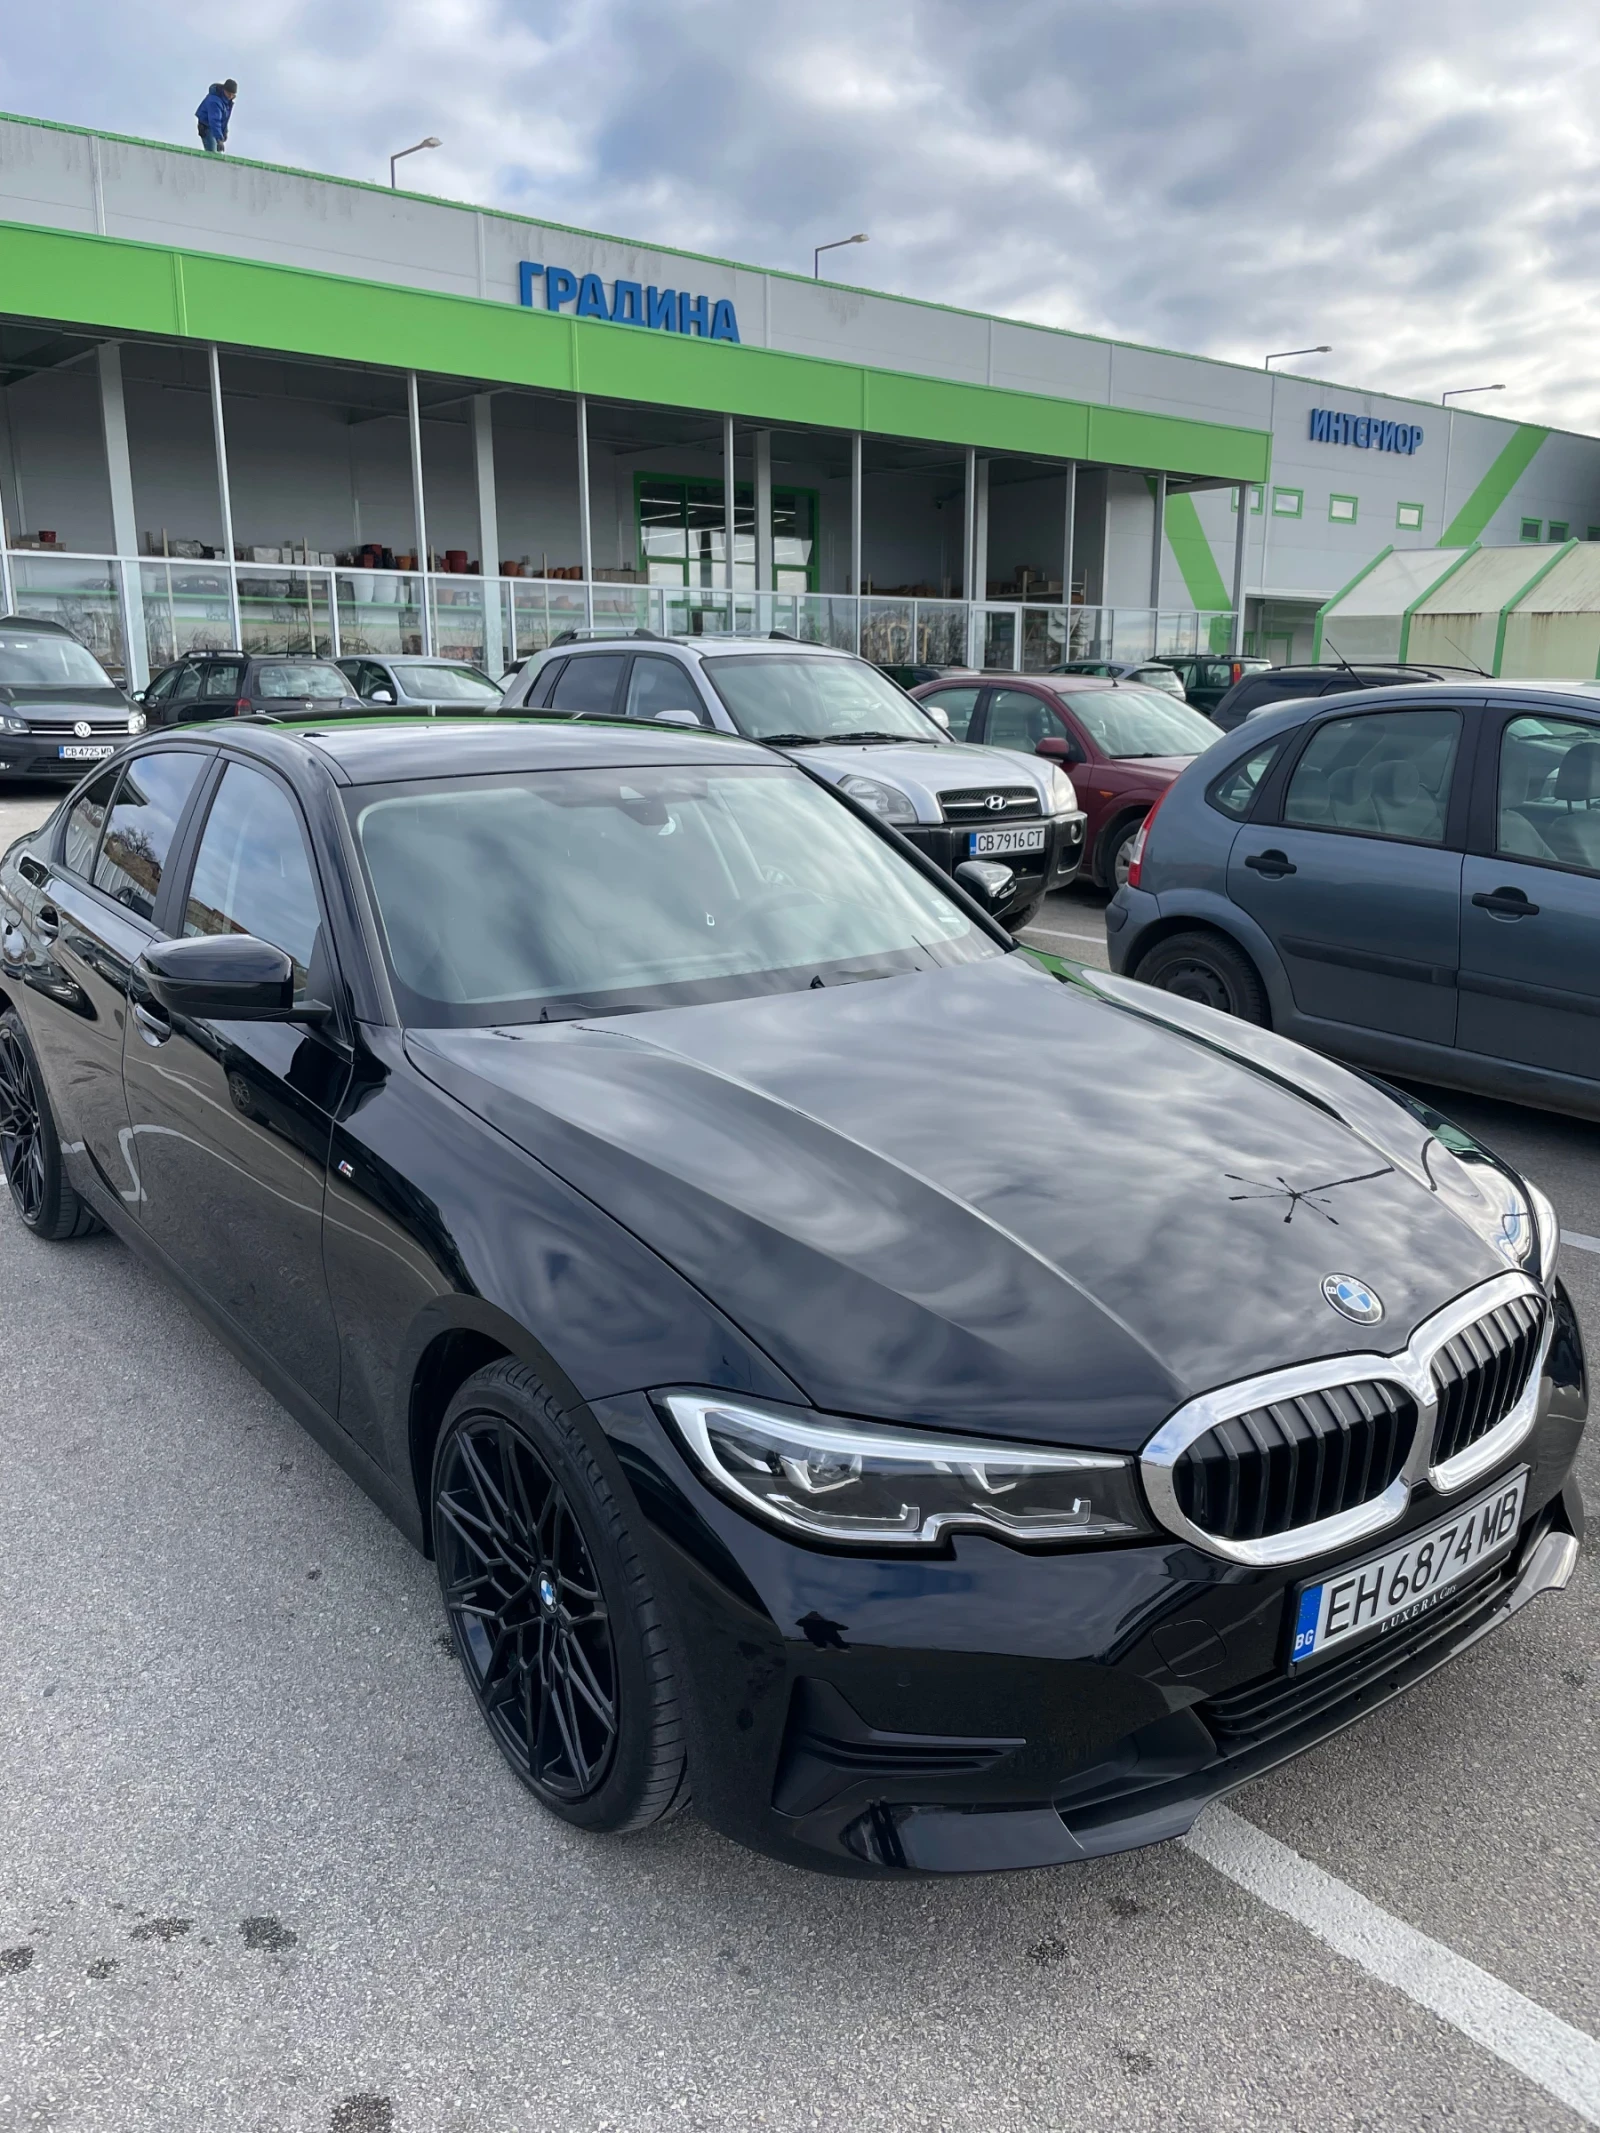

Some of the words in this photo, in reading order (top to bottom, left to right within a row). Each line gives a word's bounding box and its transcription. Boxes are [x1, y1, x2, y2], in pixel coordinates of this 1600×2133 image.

[519, 260, 740, 343] ГРАДИНА
[1310, 408, 1424, 455] ИНТЕРИОР
[1380, 1593, 1438, 1633] LUXERA
[1295, 1629, 1314, 1650] BG
